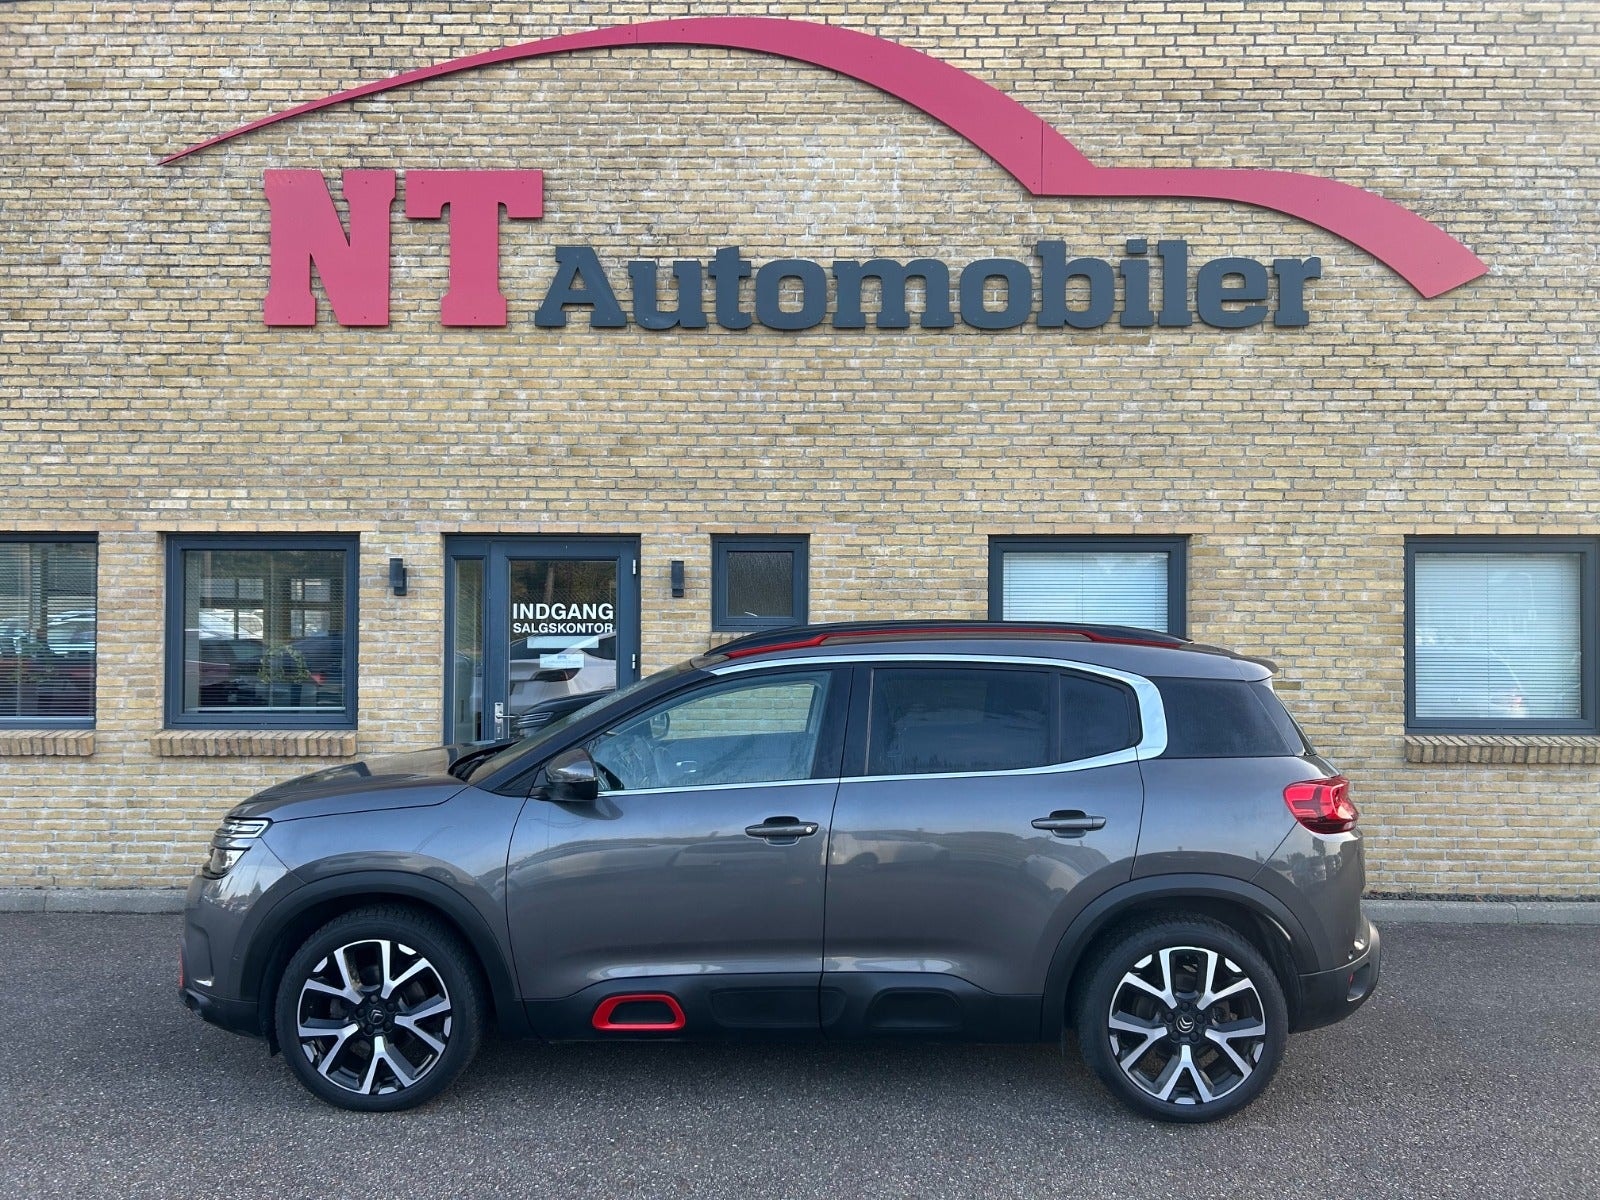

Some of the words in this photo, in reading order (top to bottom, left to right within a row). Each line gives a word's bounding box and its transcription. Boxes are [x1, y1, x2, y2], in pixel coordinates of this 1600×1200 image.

[264, 169, 544, 327] NT
[535, 239, 1321, 330] Automobiler
[512, 603, 614, 620] INDGANG
[512, 622, 614, 633] SALGSKONTOR
